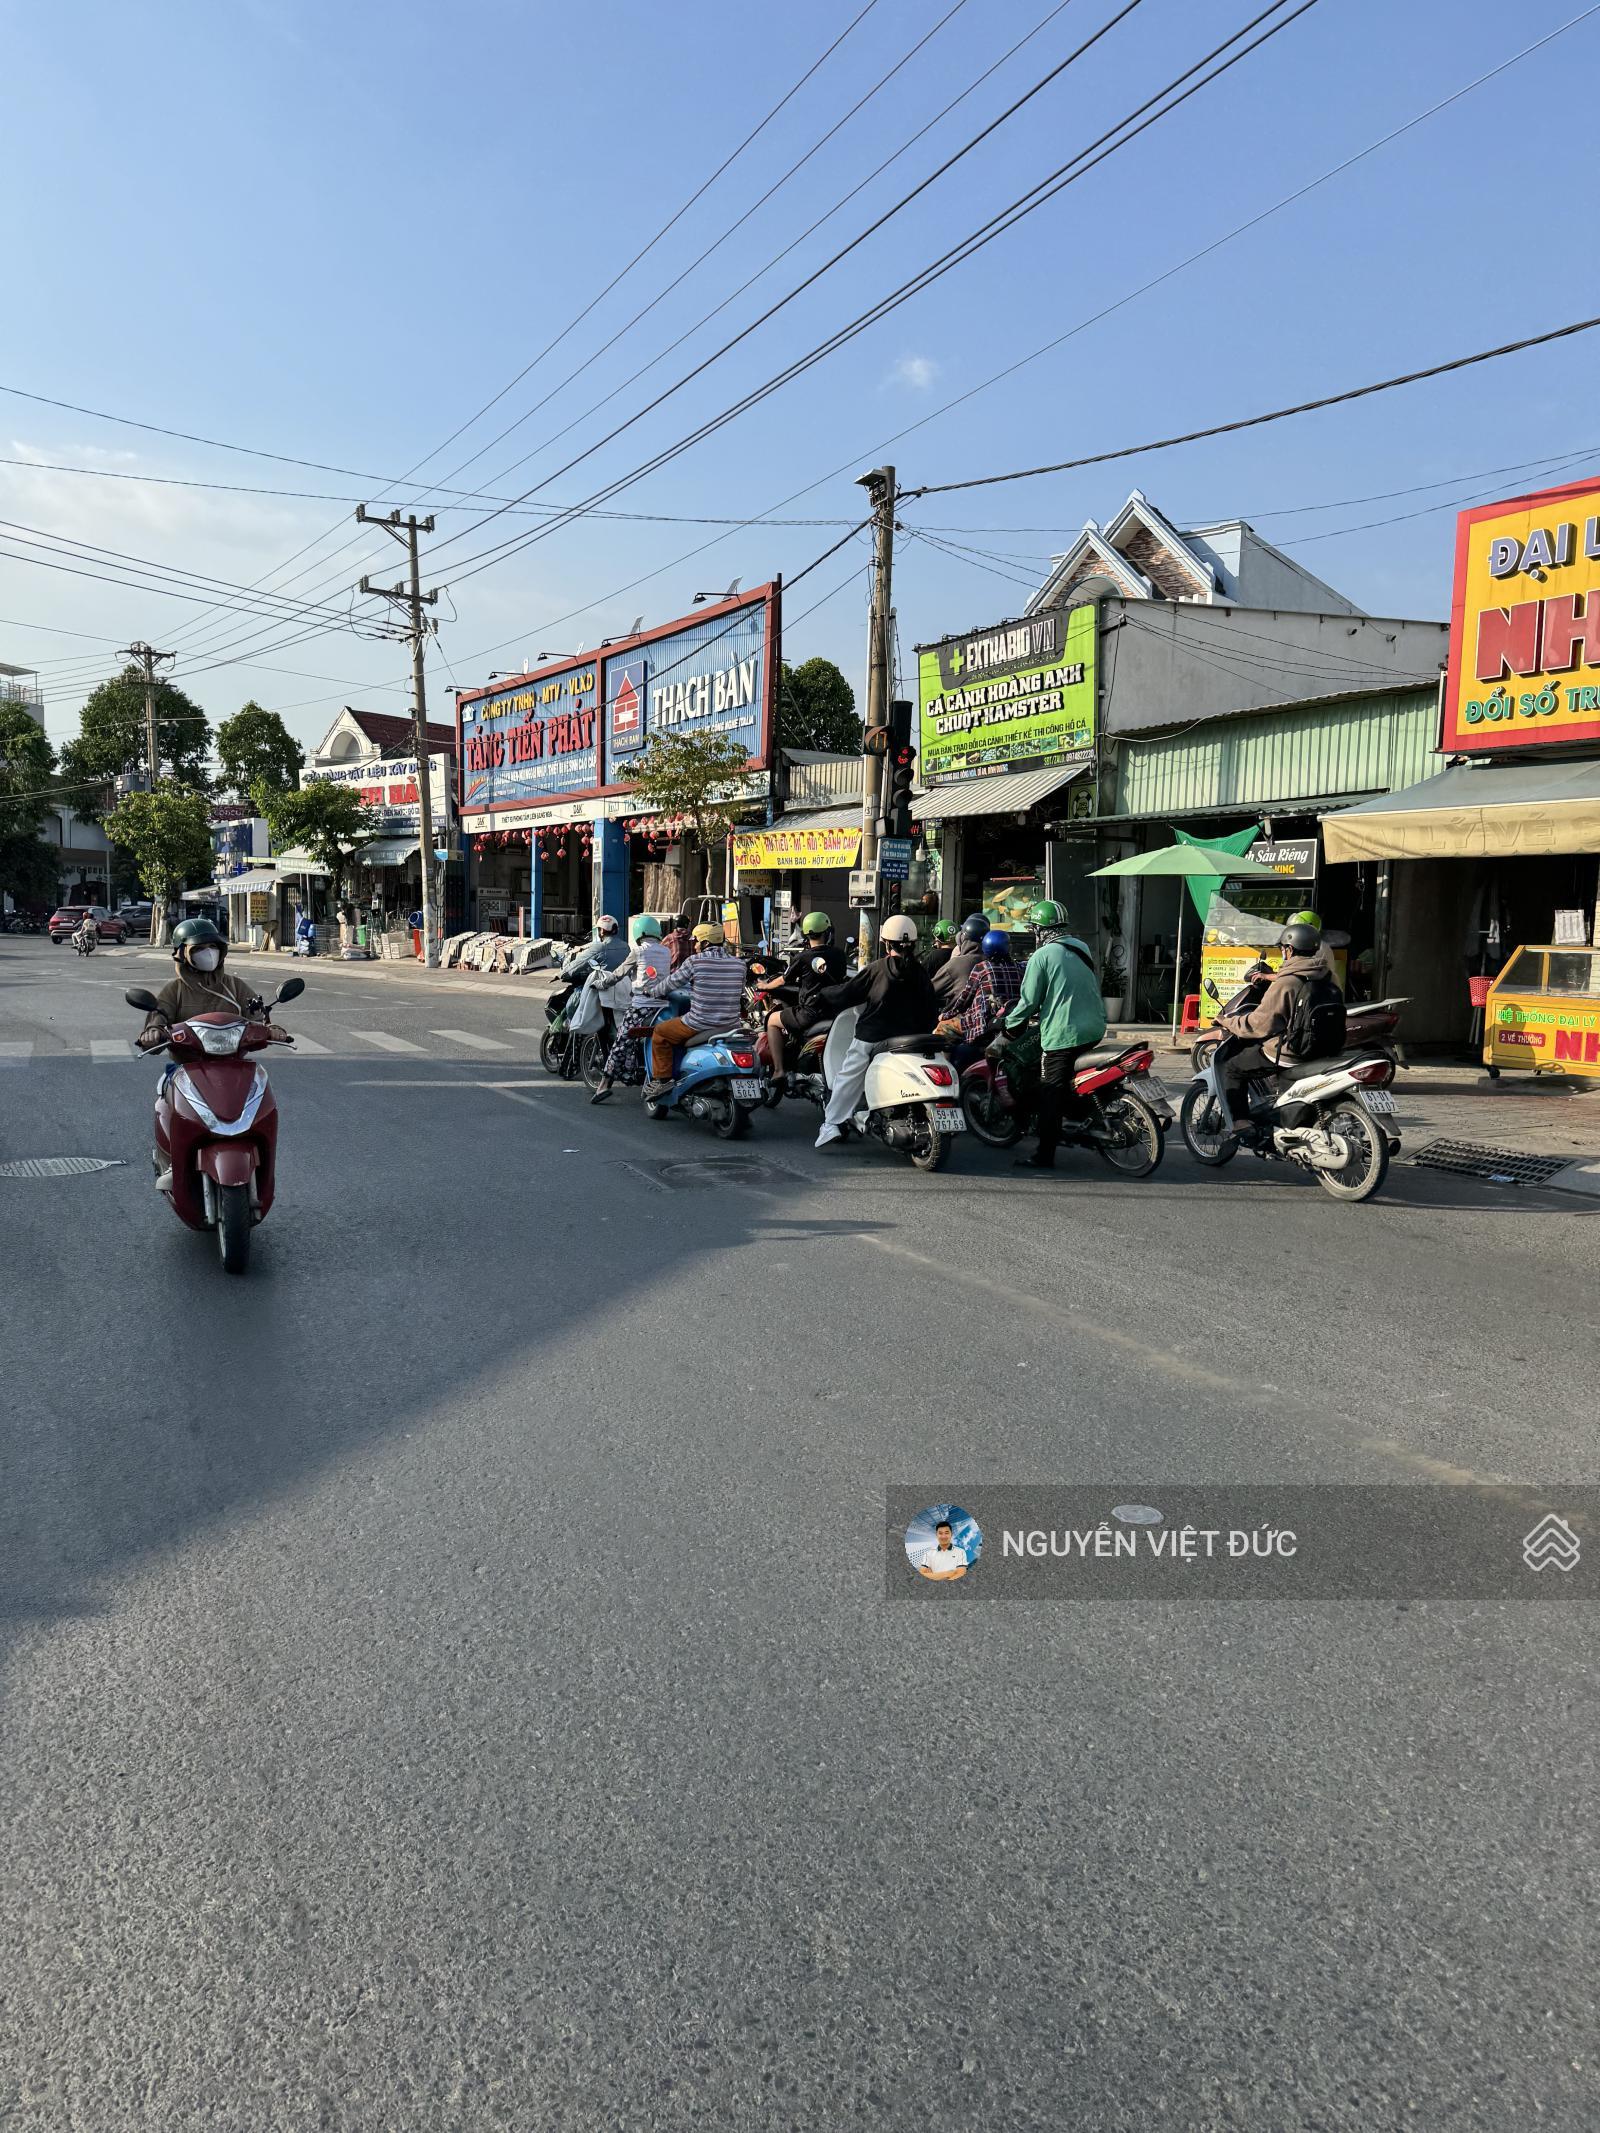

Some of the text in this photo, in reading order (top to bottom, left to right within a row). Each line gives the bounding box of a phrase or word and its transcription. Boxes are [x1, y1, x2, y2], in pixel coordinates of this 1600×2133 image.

[1488, 522, 1570, 580] ĐẠI
[1032, 618, 1056, 655] VN
[542, 683, 561, 704] MTV
[569, 672, 594, 697] VLXD
[713, 651, 757, 713] BÀN
[988, 674, 1045, 703] HOÀNG
[1044, 663, 1084, 689] ANH
[1465, 686, 1512, 723] ĐỔI
[1519, 681, 1557, 717] SỐ
[1501, 1033, 1506, 1042] 2
